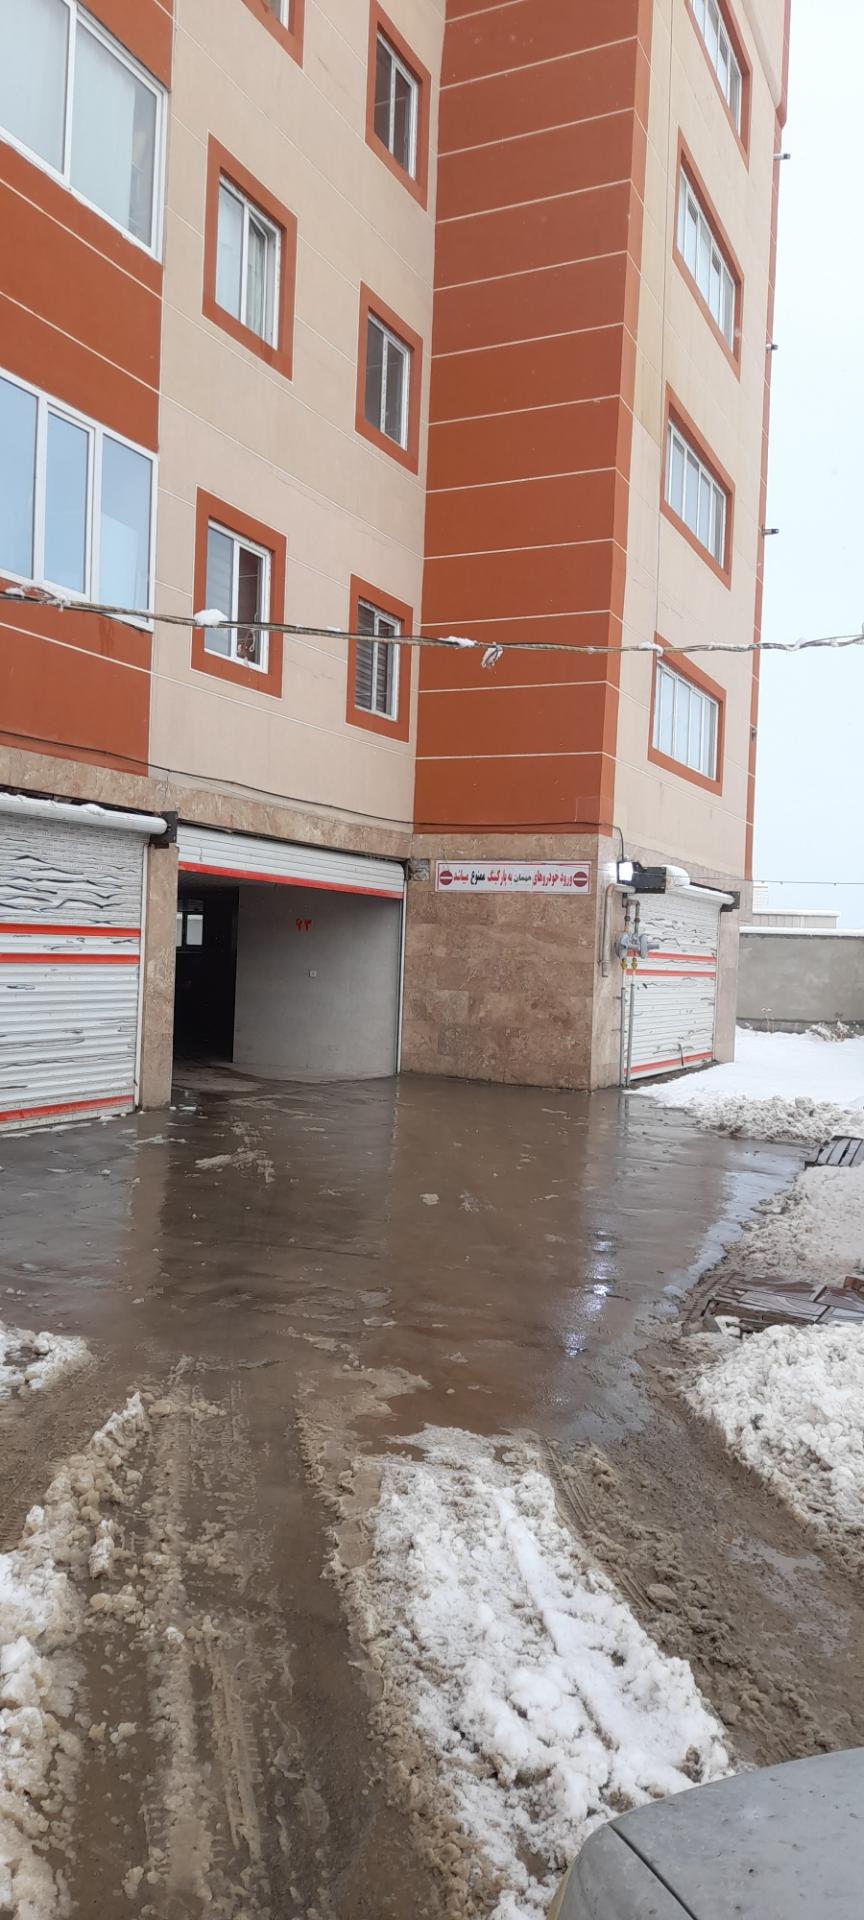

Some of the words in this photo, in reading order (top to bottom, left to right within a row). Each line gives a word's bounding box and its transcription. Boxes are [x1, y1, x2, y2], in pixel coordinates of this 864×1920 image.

[470, 870, 486, 885] ممنوع
[487, 869, 507, 886] پارکینگ
[533, 870, 559, 887] خودروهای
[560, 872, 573, 887] ورود
